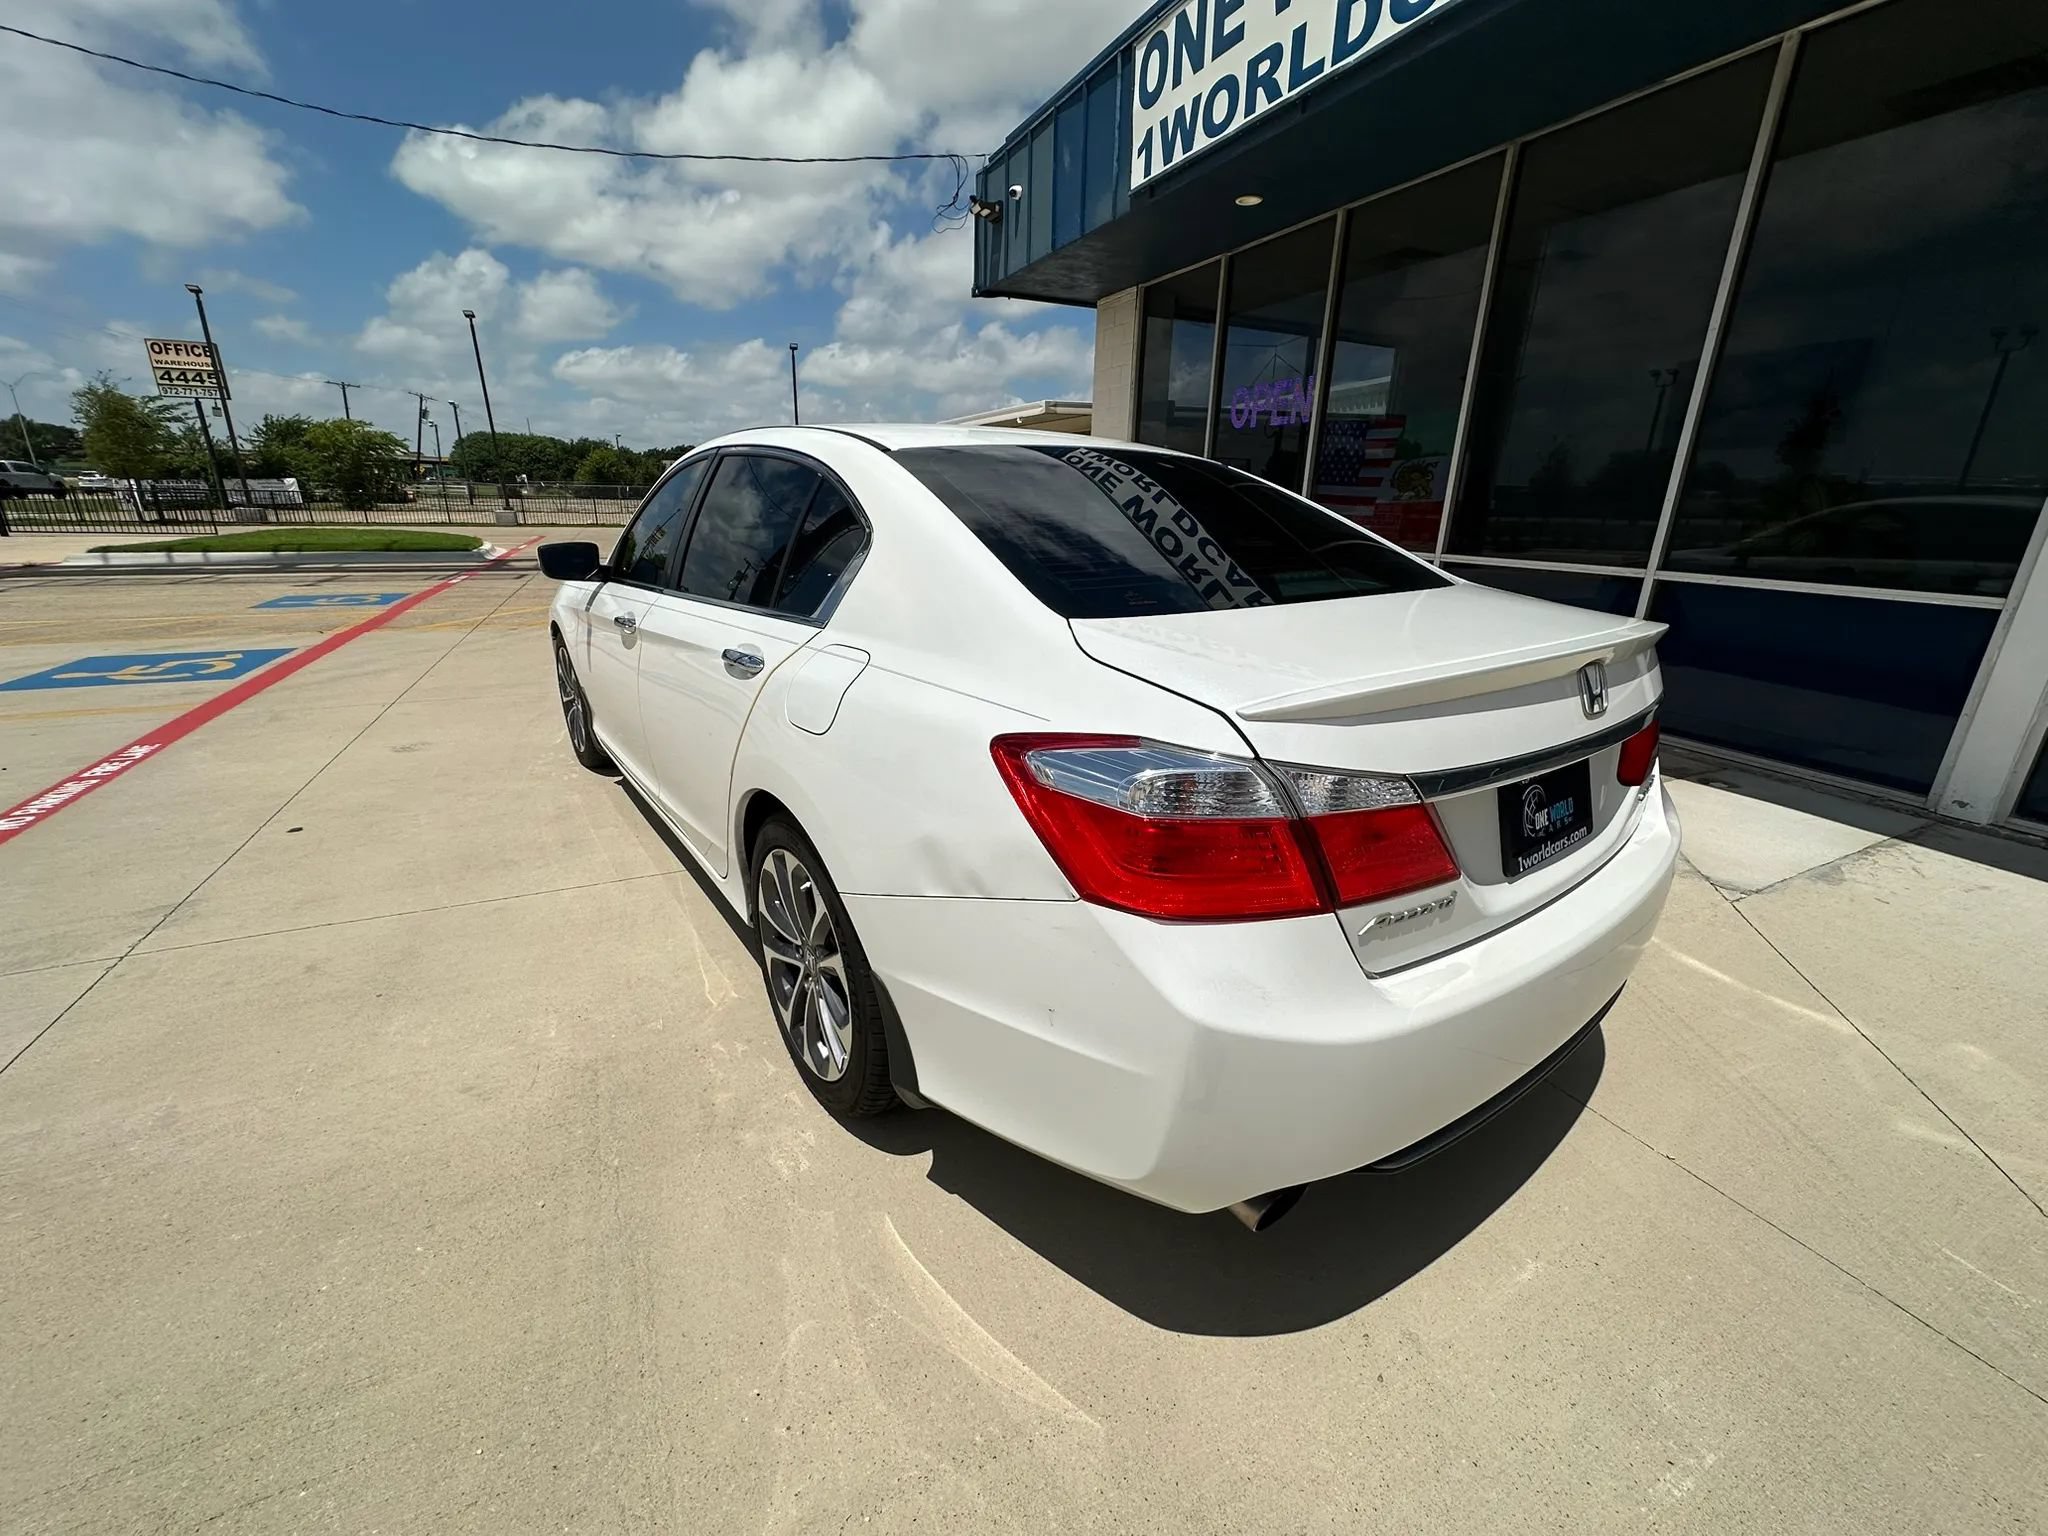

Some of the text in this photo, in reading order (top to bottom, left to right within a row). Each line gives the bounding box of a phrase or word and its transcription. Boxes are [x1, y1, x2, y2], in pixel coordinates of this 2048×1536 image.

[1138, 0, 1246, 111] ONE
[149, 341, 213, 358] OFFICE
[153, 358, 215, 369] WAREHOUS
[159, 369, 218, 385] 4445
[1231, 375, 1314, 429] OPEN
[1534, 796, 1575, 830] ONE WORLD
[1518, 826, 1588, 872] 1worldcars.com
